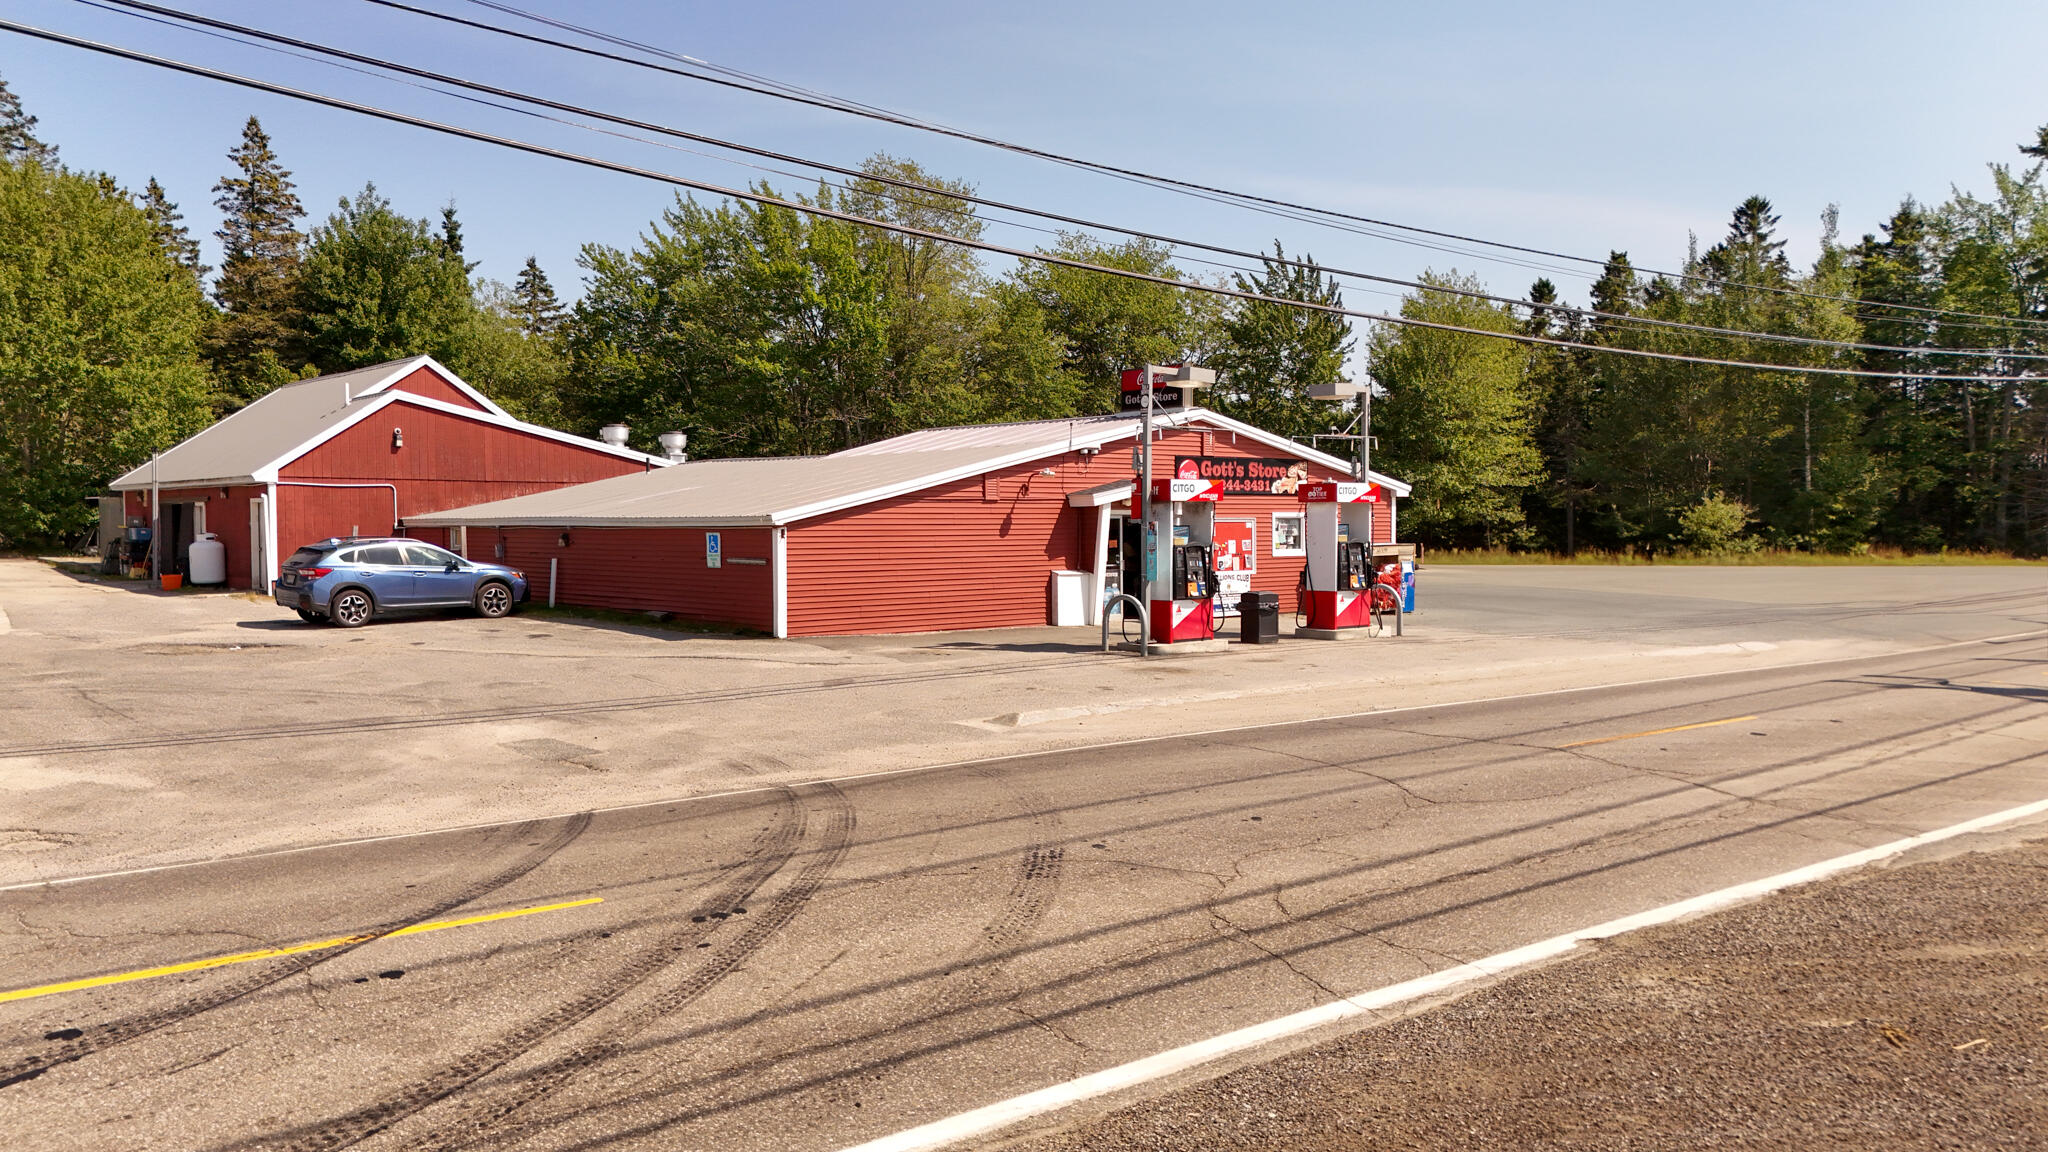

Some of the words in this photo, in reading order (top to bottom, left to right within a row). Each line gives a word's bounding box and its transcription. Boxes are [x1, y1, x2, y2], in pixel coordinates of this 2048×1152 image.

[1153, 392, 1178, 402] Store
[1200, 460, 1245, 477] Gott's
[1248, 462, 1287, 478] Store
[1172, 483, 1195, 493] CITGO
[1338, 486, 1357, 495] CITGO
[1236, 574, 1250, 582] CLUB
